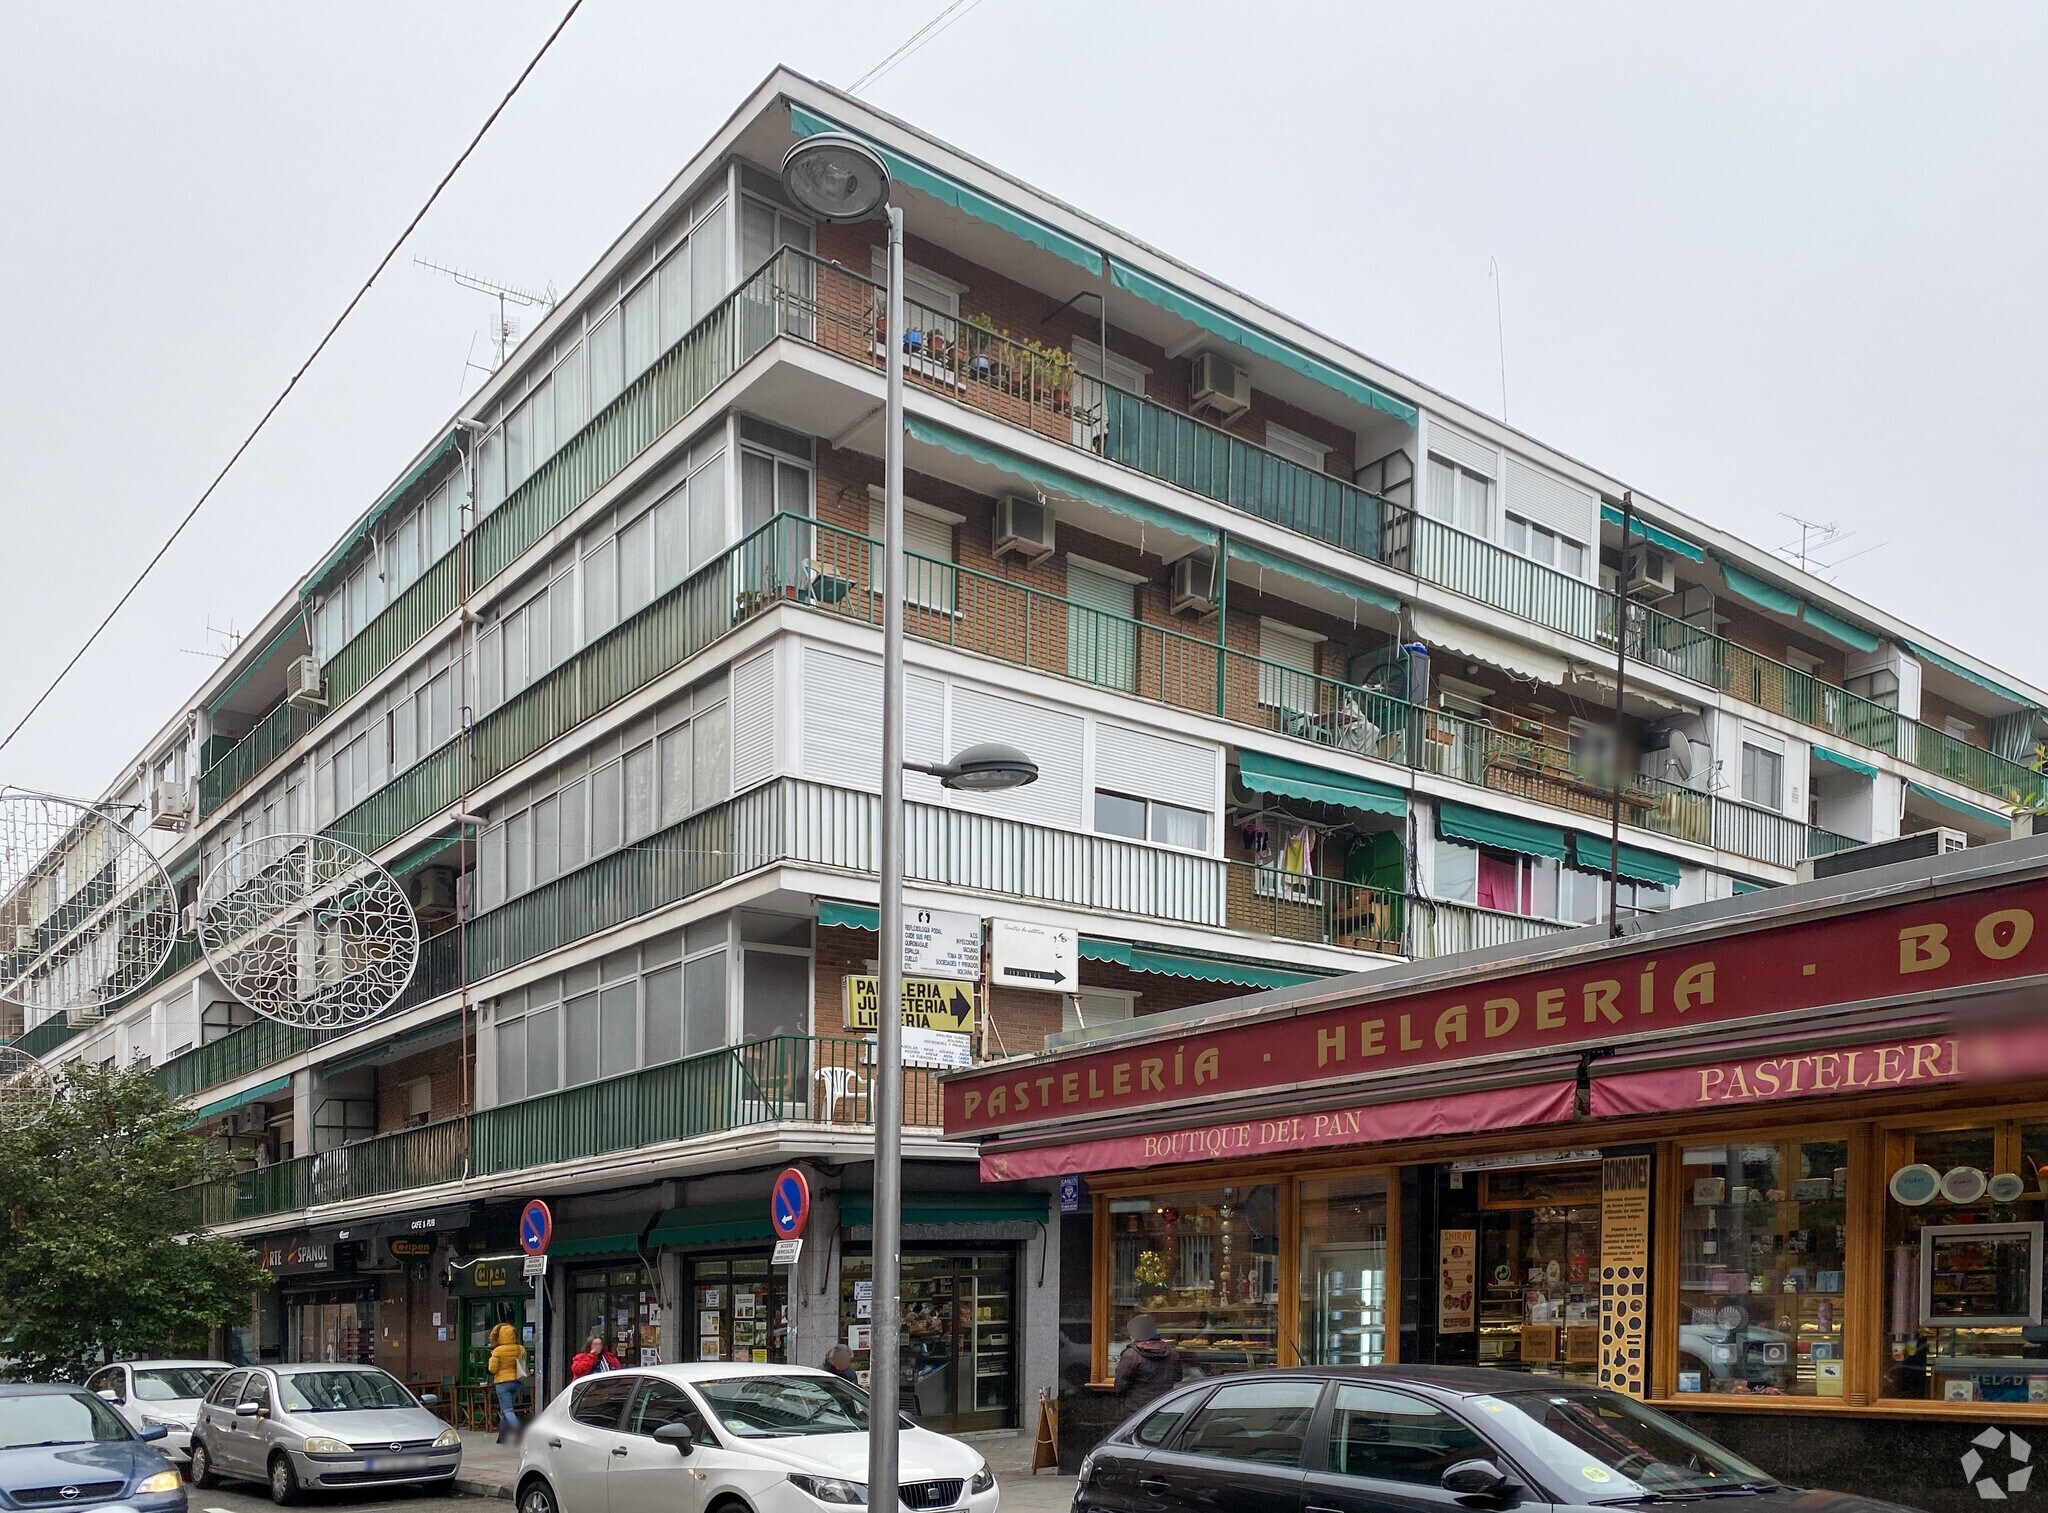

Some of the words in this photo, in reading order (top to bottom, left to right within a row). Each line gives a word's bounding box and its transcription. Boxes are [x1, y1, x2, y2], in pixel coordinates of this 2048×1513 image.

[1317, 961, 1718, 1068] HELADERÍA
[964, 1045, 1219, 1120] PASTELERÍA
[1143, 1124, 1250, 1156] BOUTIQUE
[1259, 1118, 1306, 1145] DEL
[1312, 1110, 1362, 1138] PAN
[1604, 1158, 1648, 1191] BOMBONES
[1445, 1231, 1472, 1241] SHIRAY
